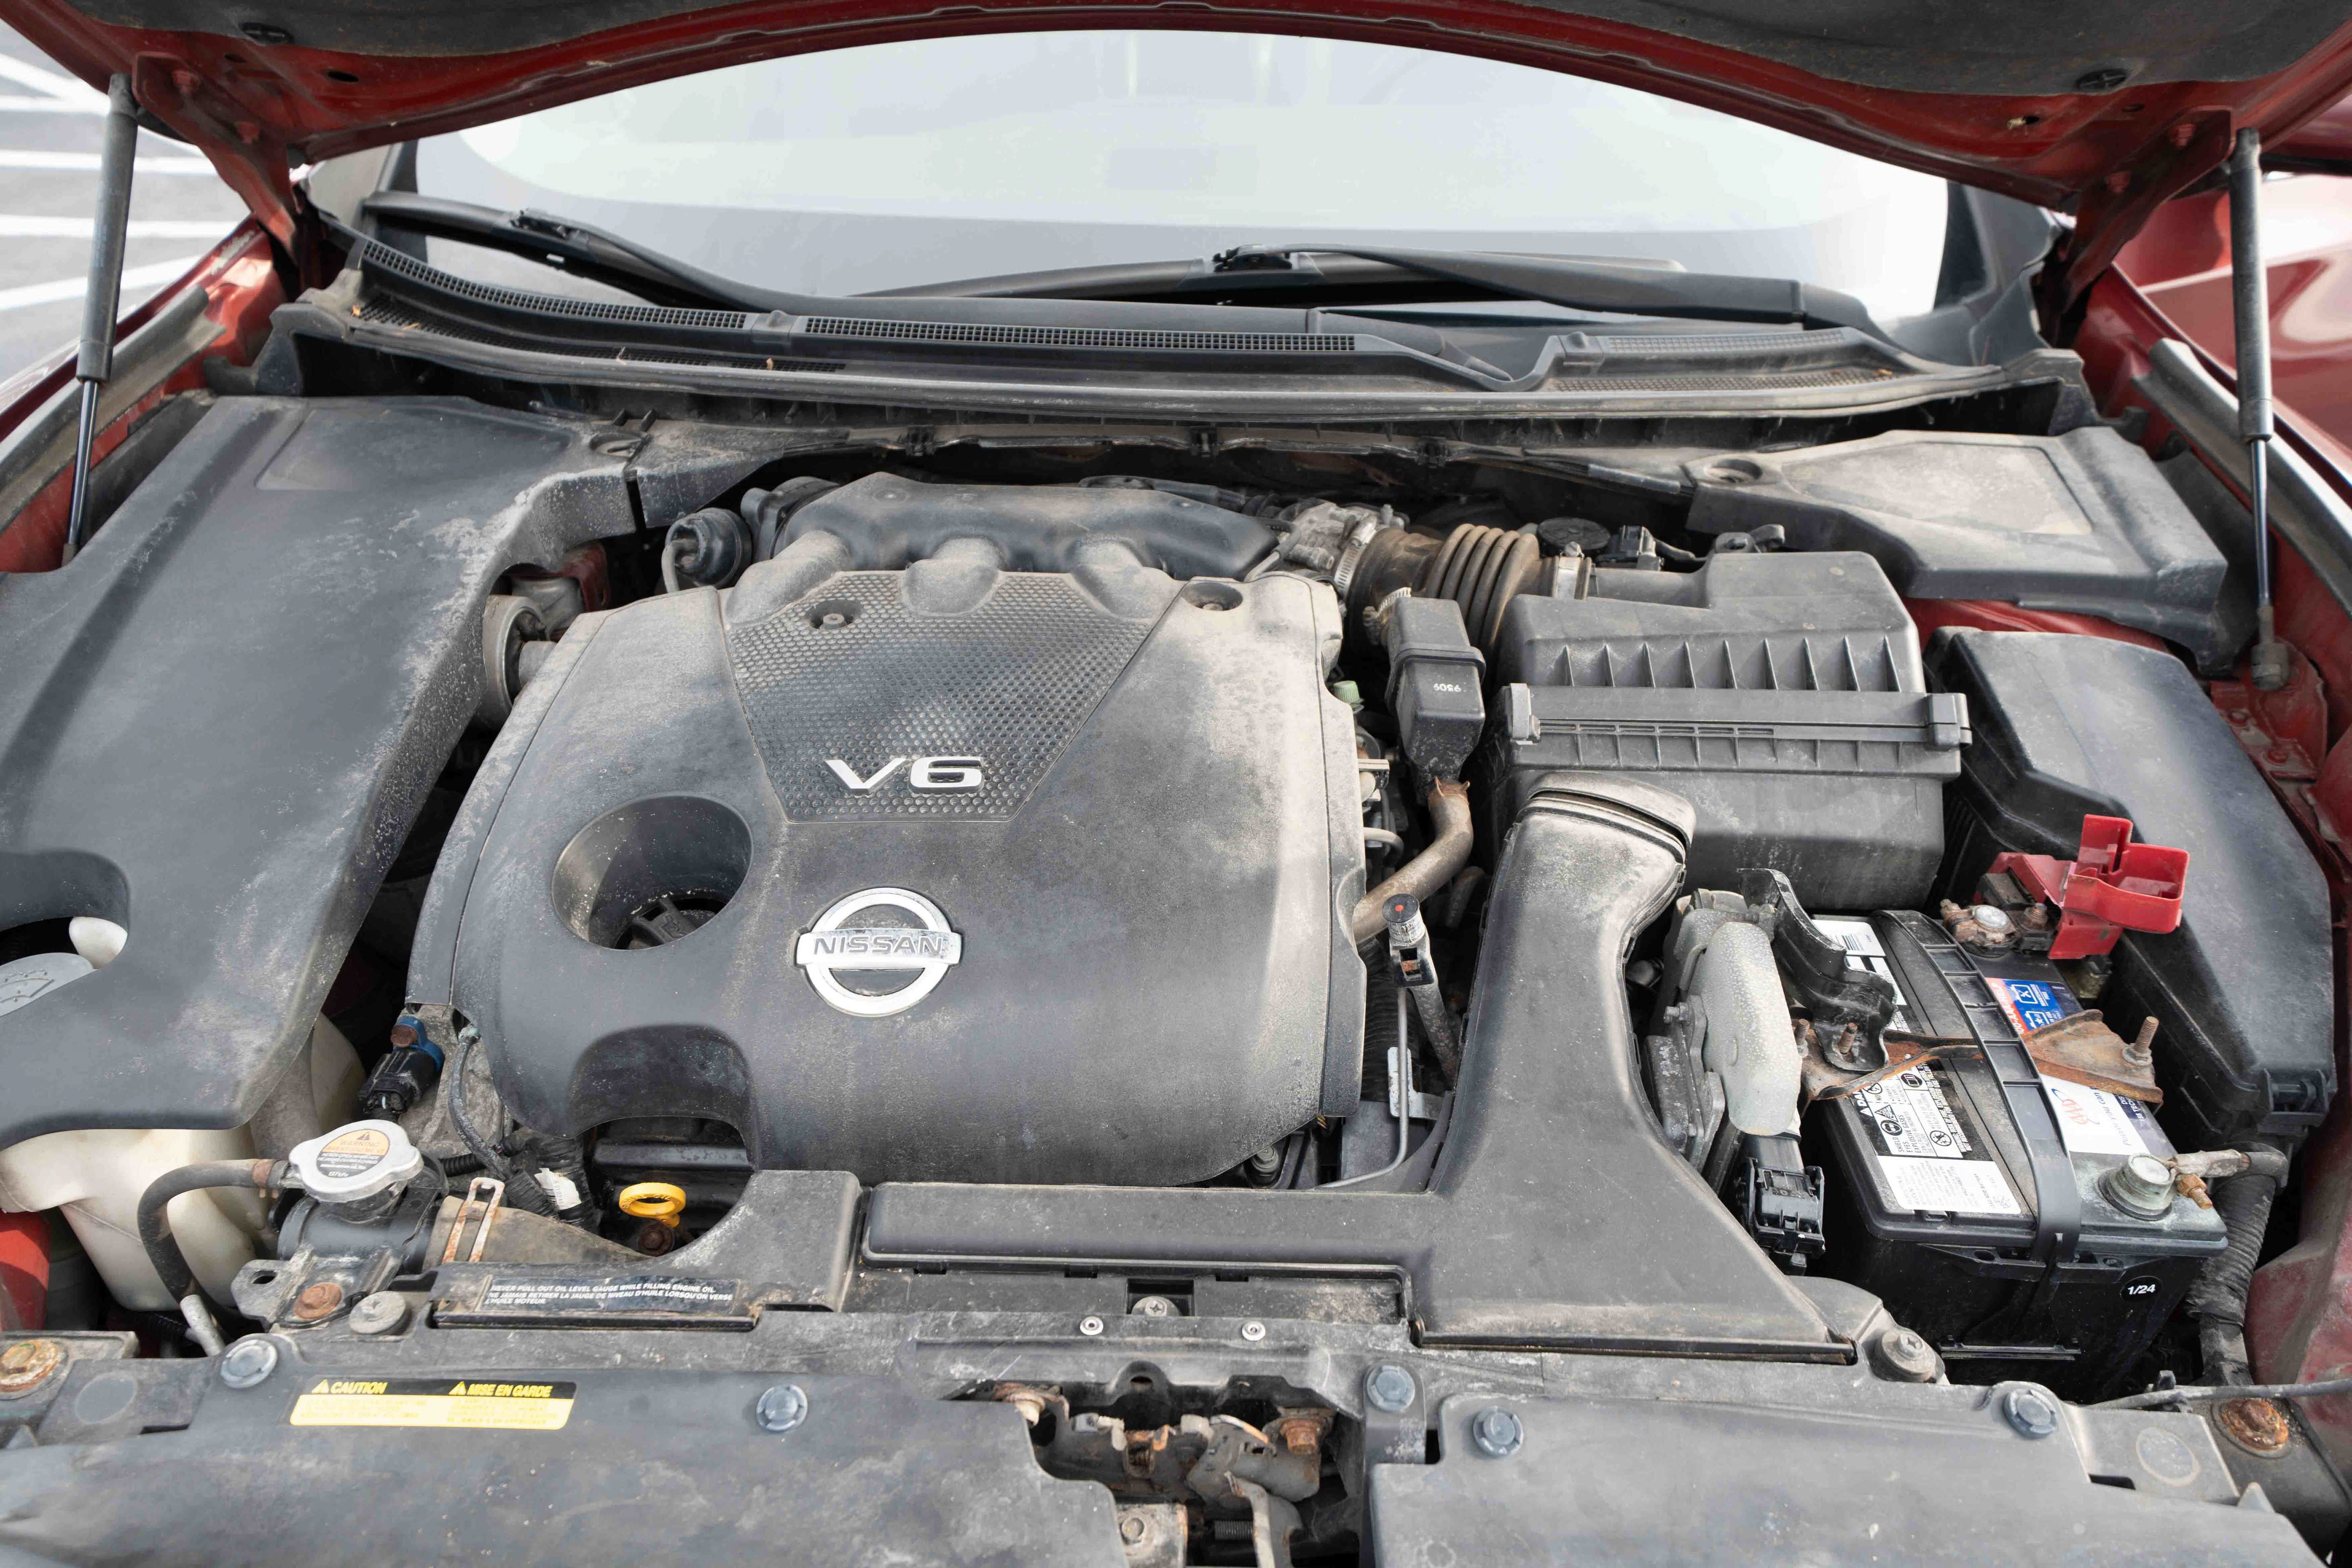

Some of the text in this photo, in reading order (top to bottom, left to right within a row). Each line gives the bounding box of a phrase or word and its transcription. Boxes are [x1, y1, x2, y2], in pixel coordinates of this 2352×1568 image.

[824, 756, 983, 795] V6
[813, 935, 942, 955] NISSAN
[2094, 1092, 2106, 1105] can
[2061, 1098, 2089, 1125] AAA
[1897, 1114, 1921, 1153] EXPLOSIVE GASES
[1892, 1137, 1905, 1152] SHIELD
[665, 1291, 708, 1300] LORSQU'ON
[2128, 1284, 2156, 1295] 1/24
[331, 1382, 388, 1394] CAUTION
[467, 1384, 553, 1398] MISE EN GARDE
